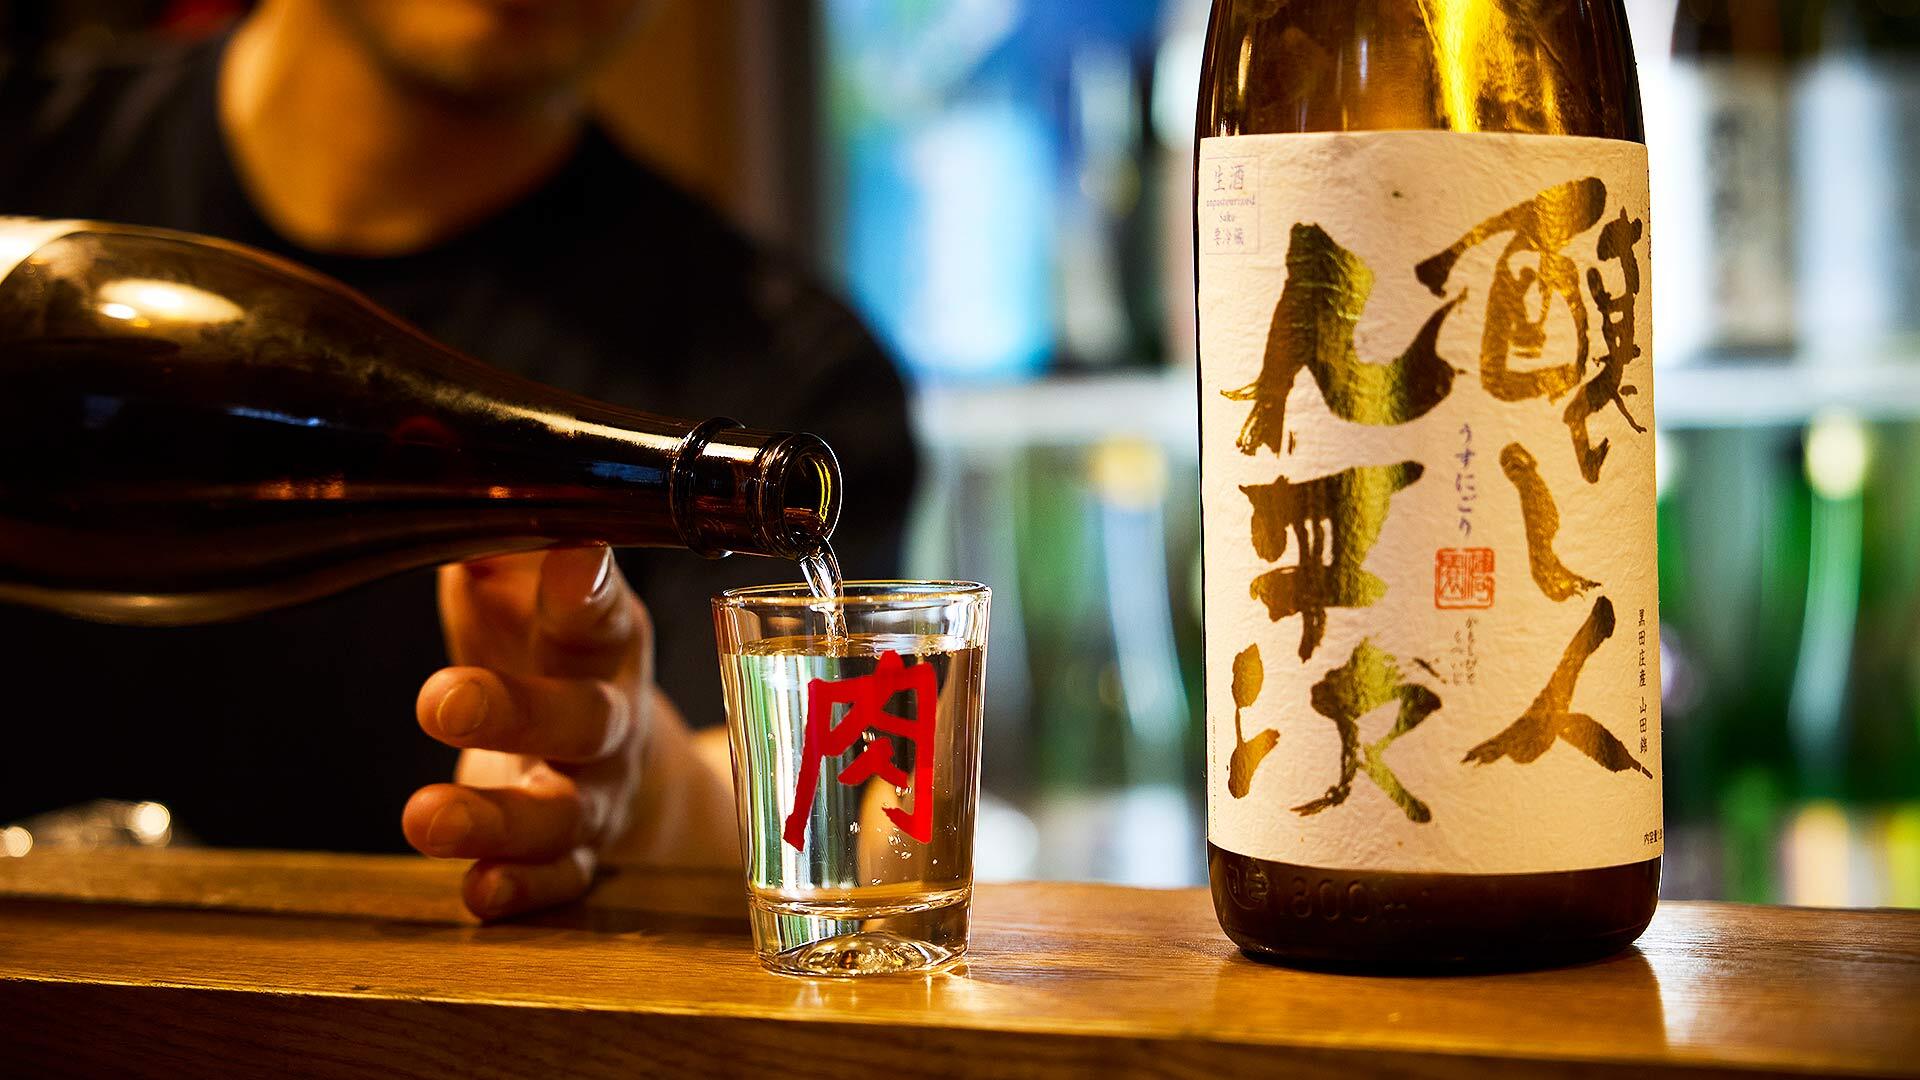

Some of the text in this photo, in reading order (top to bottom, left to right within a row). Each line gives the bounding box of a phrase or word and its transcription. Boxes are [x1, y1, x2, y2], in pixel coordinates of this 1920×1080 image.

[1213, 163, 1245, 192] 生酒
[1454, 423, 1477, 537] うすにごり
[783, 650, 938, 852] 肉
[1639, 696, 1649, 754] 山田錦
